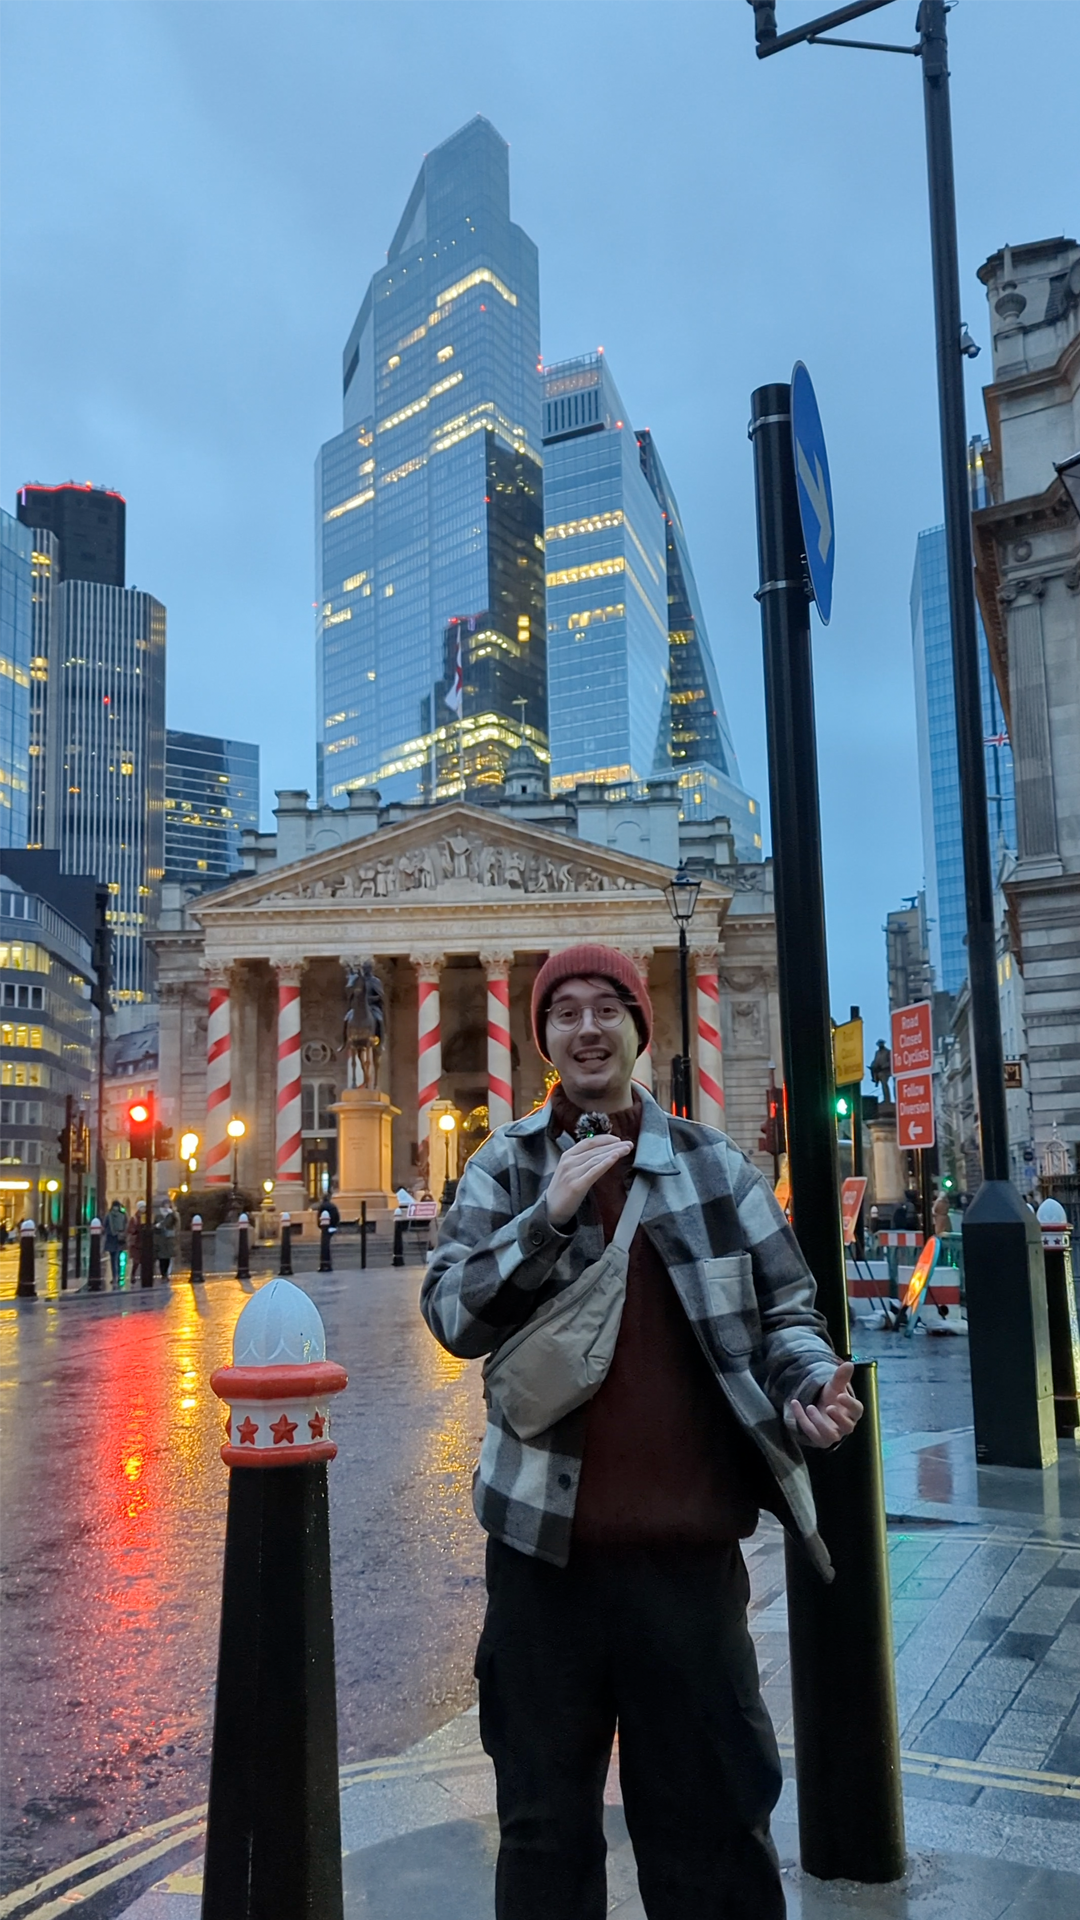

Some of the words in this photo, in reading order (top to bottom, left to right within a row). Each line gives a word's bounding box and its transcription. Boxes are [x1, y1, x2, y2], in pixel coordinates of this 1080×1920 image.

[901, 1012, 919, 1030] Road
[899, 1029, 923, 1048] Closed
[894, 1053, 902, 1066] To
[903, 1047, 930, 1067] Cyclists
[903, 1083, 925, 1098] Follow
[900, 1100, 930, 1117] Diversion
